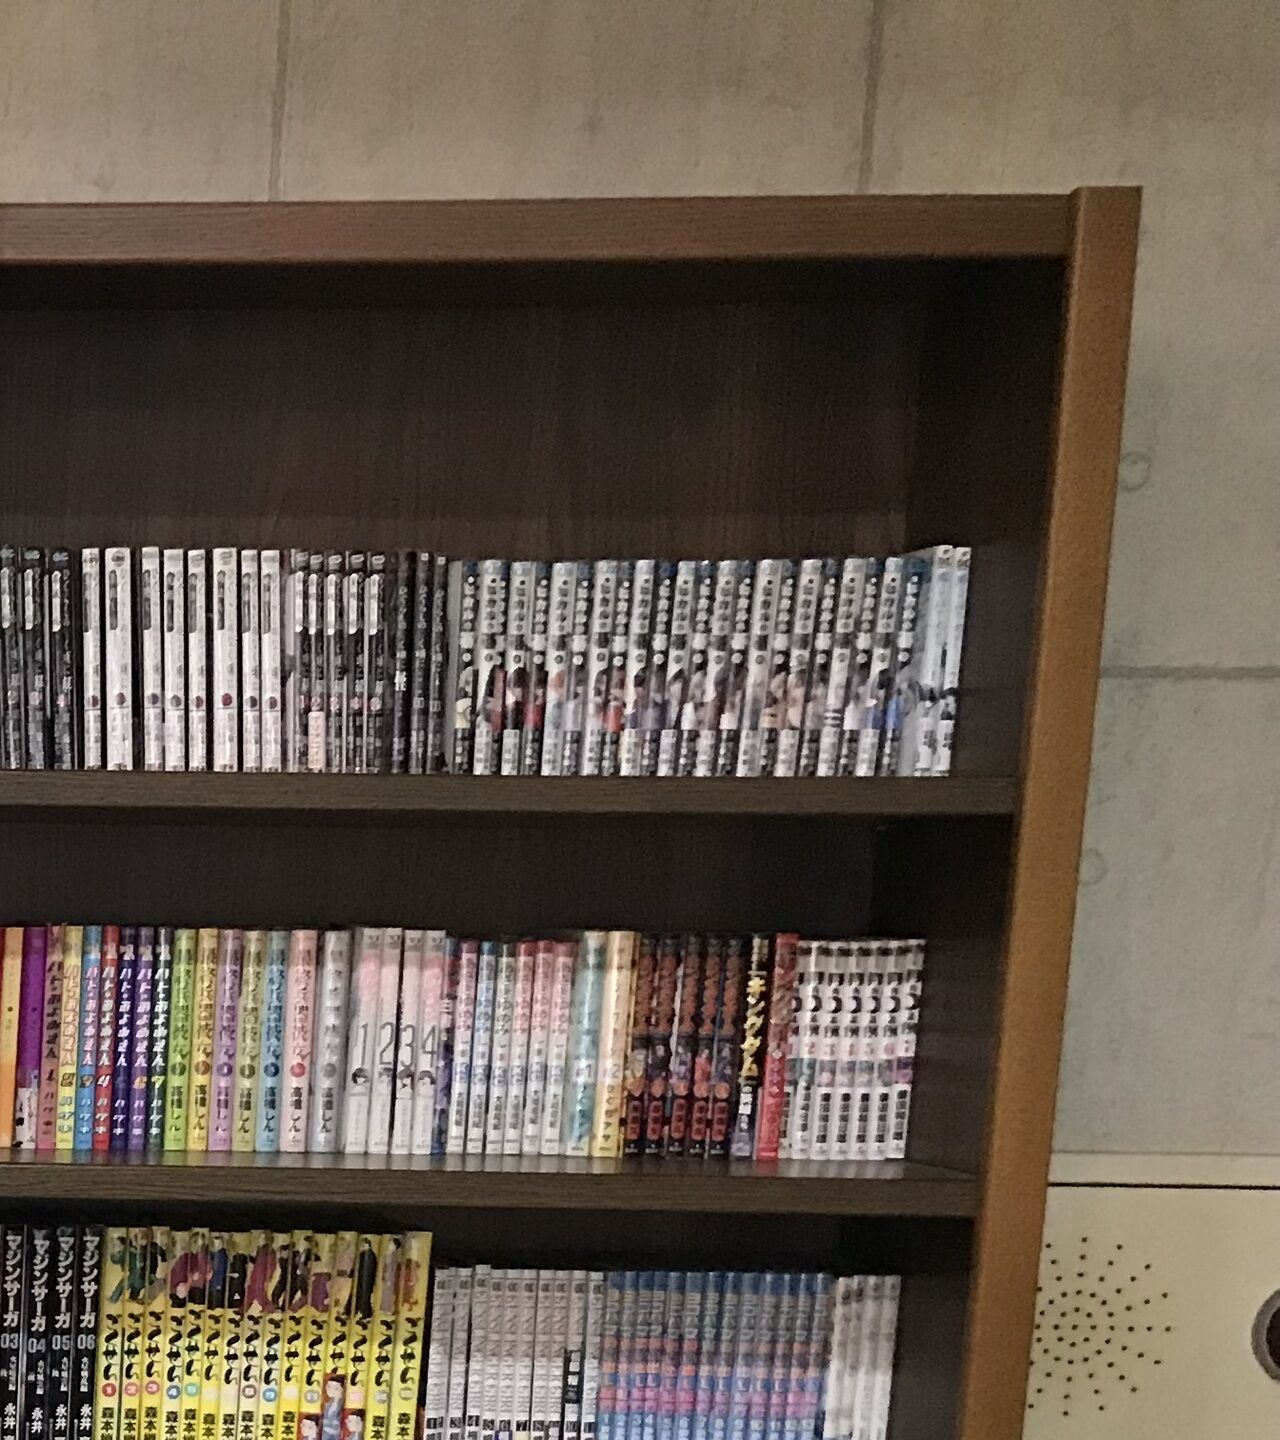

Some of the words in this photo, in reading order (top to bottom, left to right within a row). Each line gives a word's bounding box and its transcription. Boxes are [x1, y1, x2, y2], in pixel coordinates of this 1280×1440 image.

[740, 977, 765, 1076] キングダム
[3, 1235, 21, 1327] マジンサーガ
[31, 1240, 50, 1331] マジンサーガ
[55, 1237, 74, 1328] マジンサーガ
[80, 1236, 99, 1328] マジンサーガ
[0, 1333, 19, 1348] 03
[28, 1338, 45, 1353] 04
[52, 1334, 70, 1350] 05
[77, 1334, 96, 1350] 06
